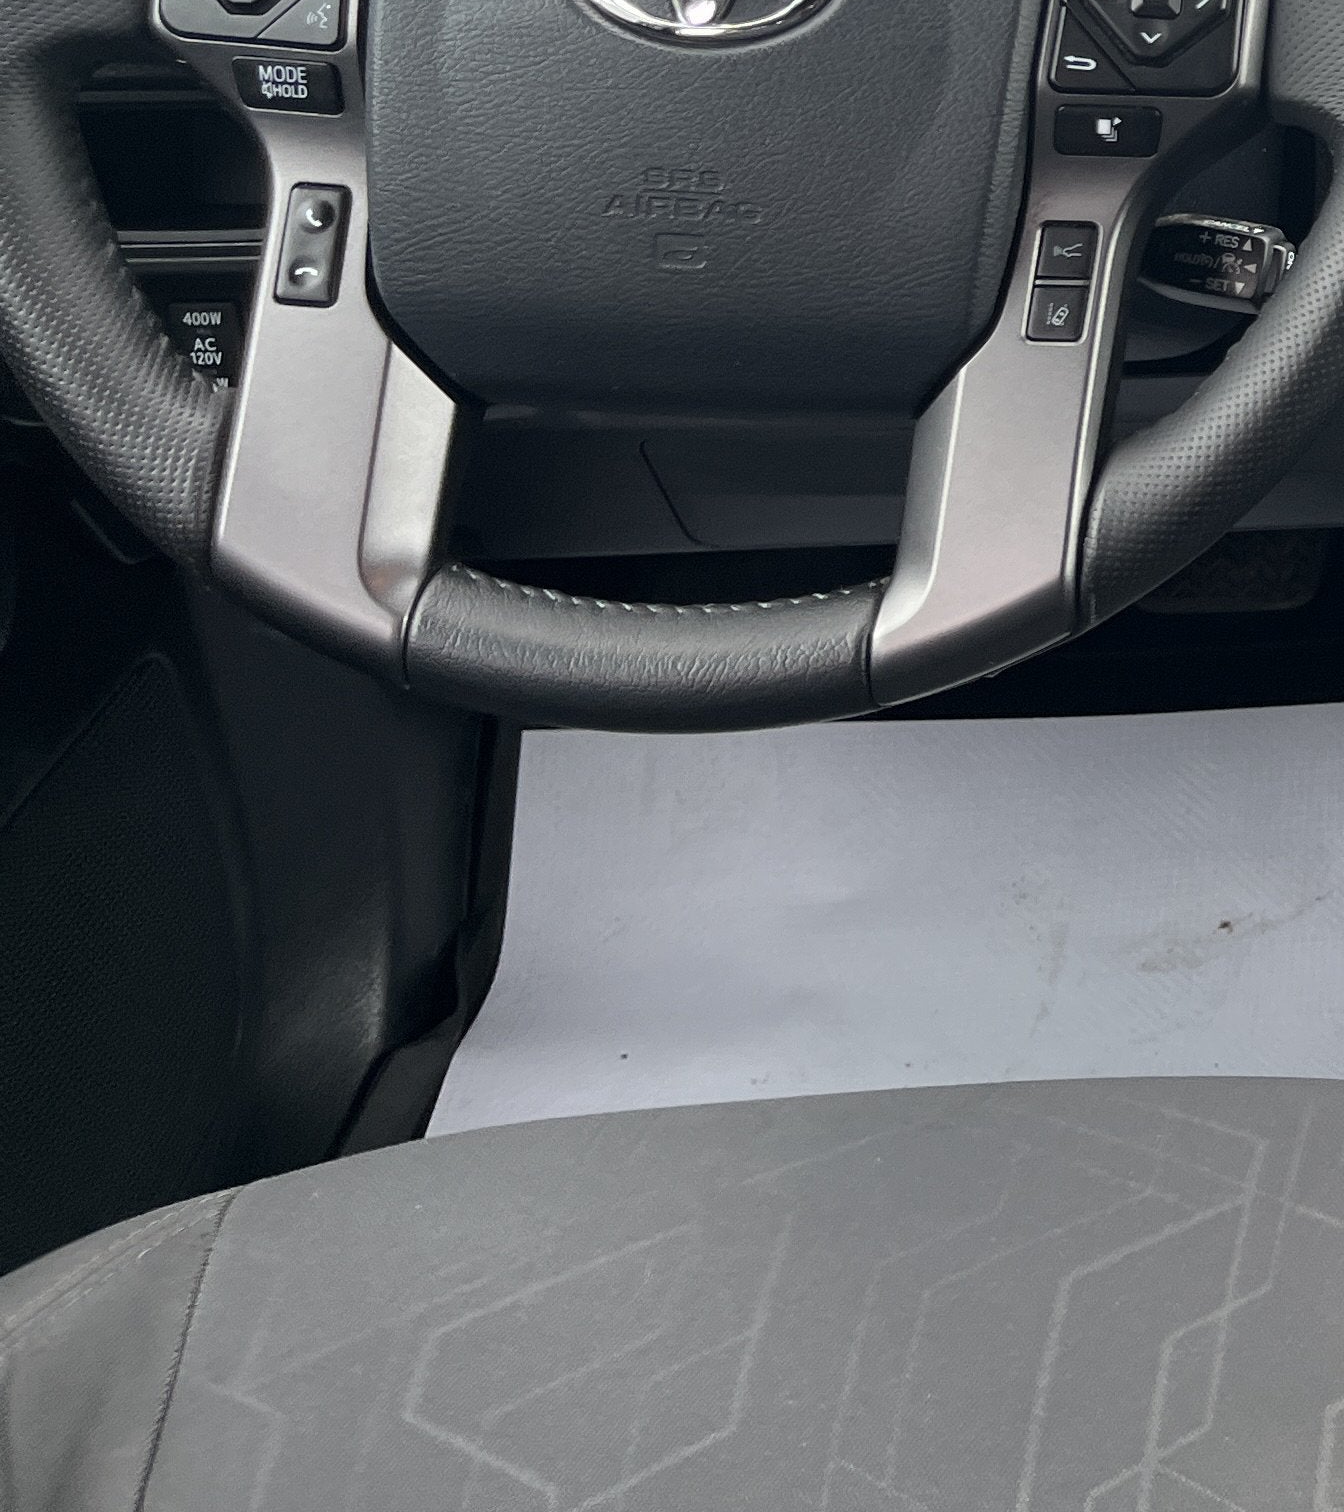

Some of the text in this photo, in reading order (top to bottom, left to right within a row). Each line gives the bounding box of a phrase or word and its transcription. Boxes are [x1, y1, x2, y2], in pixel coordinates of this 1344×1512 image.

[258, 65, 307, 84] MODE
[273, 85, 307, 99] HOLD
[1215, 234, 1240, 249] RES
[1205, 278, 1230, 292] SET
[183, 312, 222, 326] 400W
[194, 338, 217, 351] AC
[190, 351, 223, 366] 120V
